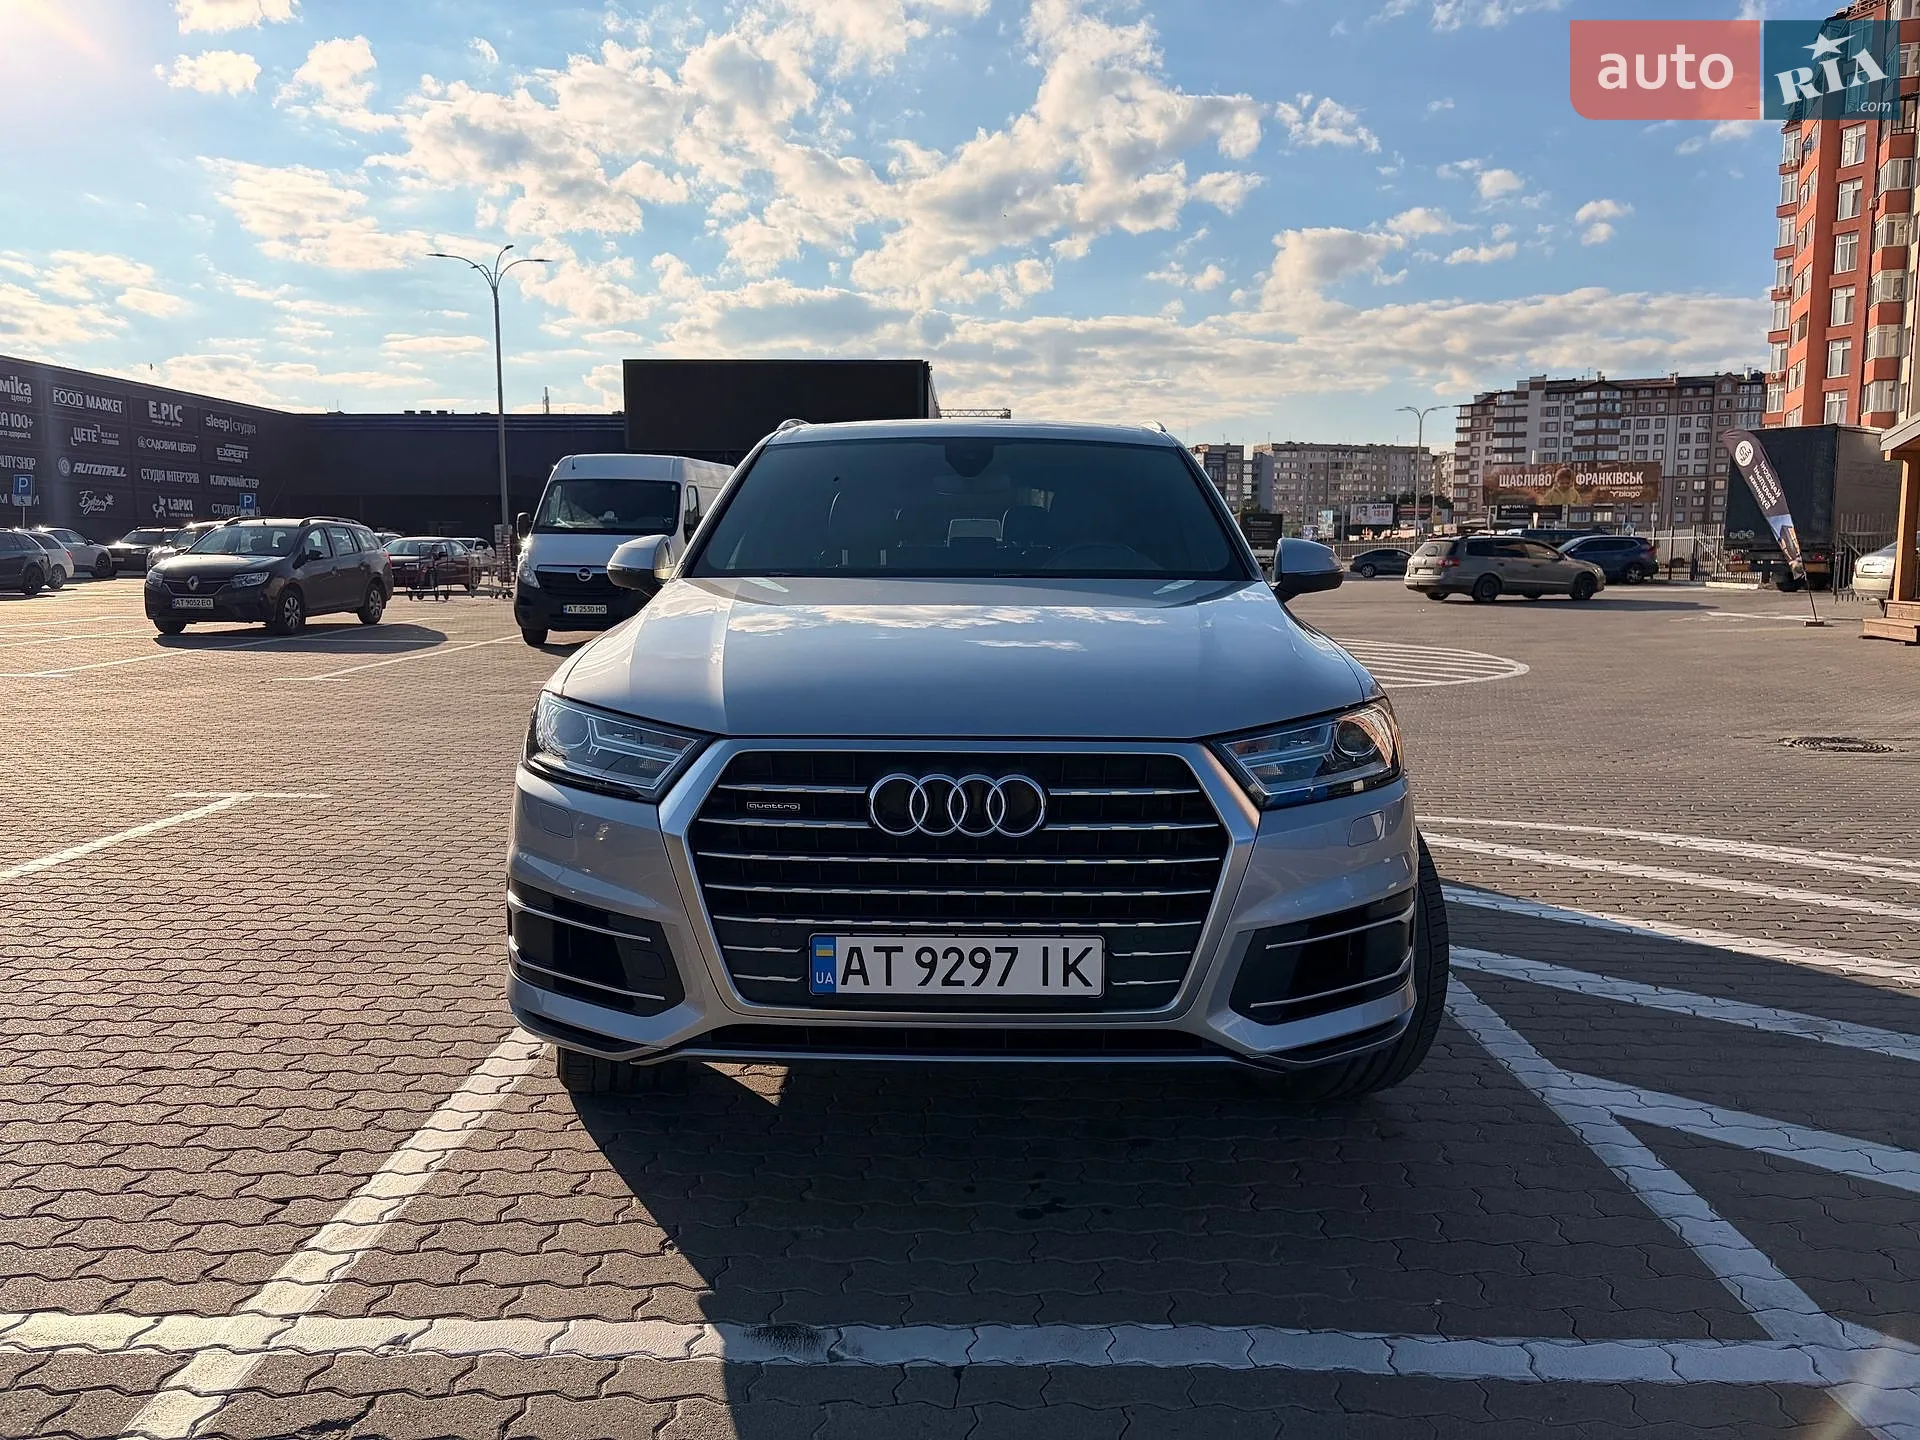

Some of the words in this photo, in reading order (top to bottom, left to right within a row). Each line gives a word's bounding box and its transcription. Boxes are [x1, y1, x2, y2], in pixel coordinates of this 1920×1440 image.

[53, 389, 84, 406] FOOD
[86, 395, 122, 414] MARKET
[73, 462, 127, 477] AUTOMALL
[18, 477, 28, 493] P
[1576, 471, 1643, 486] ФРАНКІВСЬК
[244, 495, 253, 507] P
[840, 946, 904, 987] AT
[914, 946, 1019, 988] 9297
[1041, 946, 1094, 988] IK
[815, 971, 834, 985] UA
